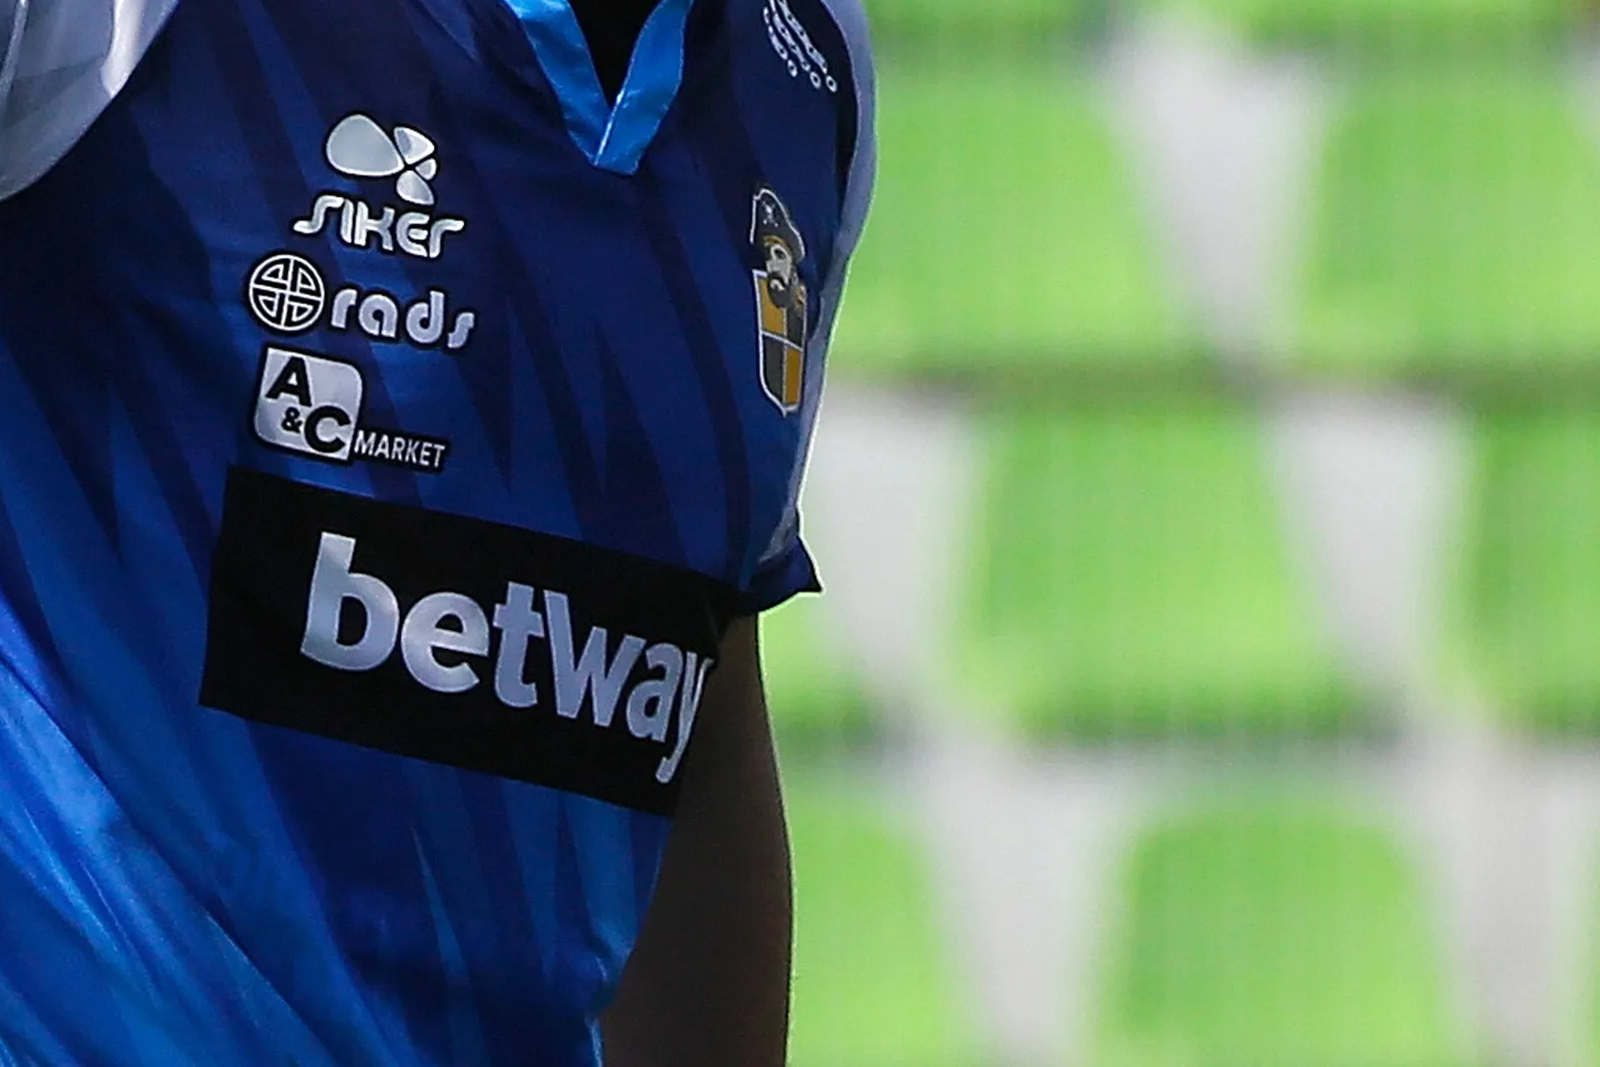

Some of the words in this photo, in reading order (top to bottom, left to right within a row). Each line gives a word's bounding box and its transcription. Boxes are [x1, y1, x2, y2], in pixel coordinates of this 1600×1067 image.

[331, 288, 475, 349] rads
[354, 430, 445, 467] MARKET
[300, 531, 715, 784] betway
